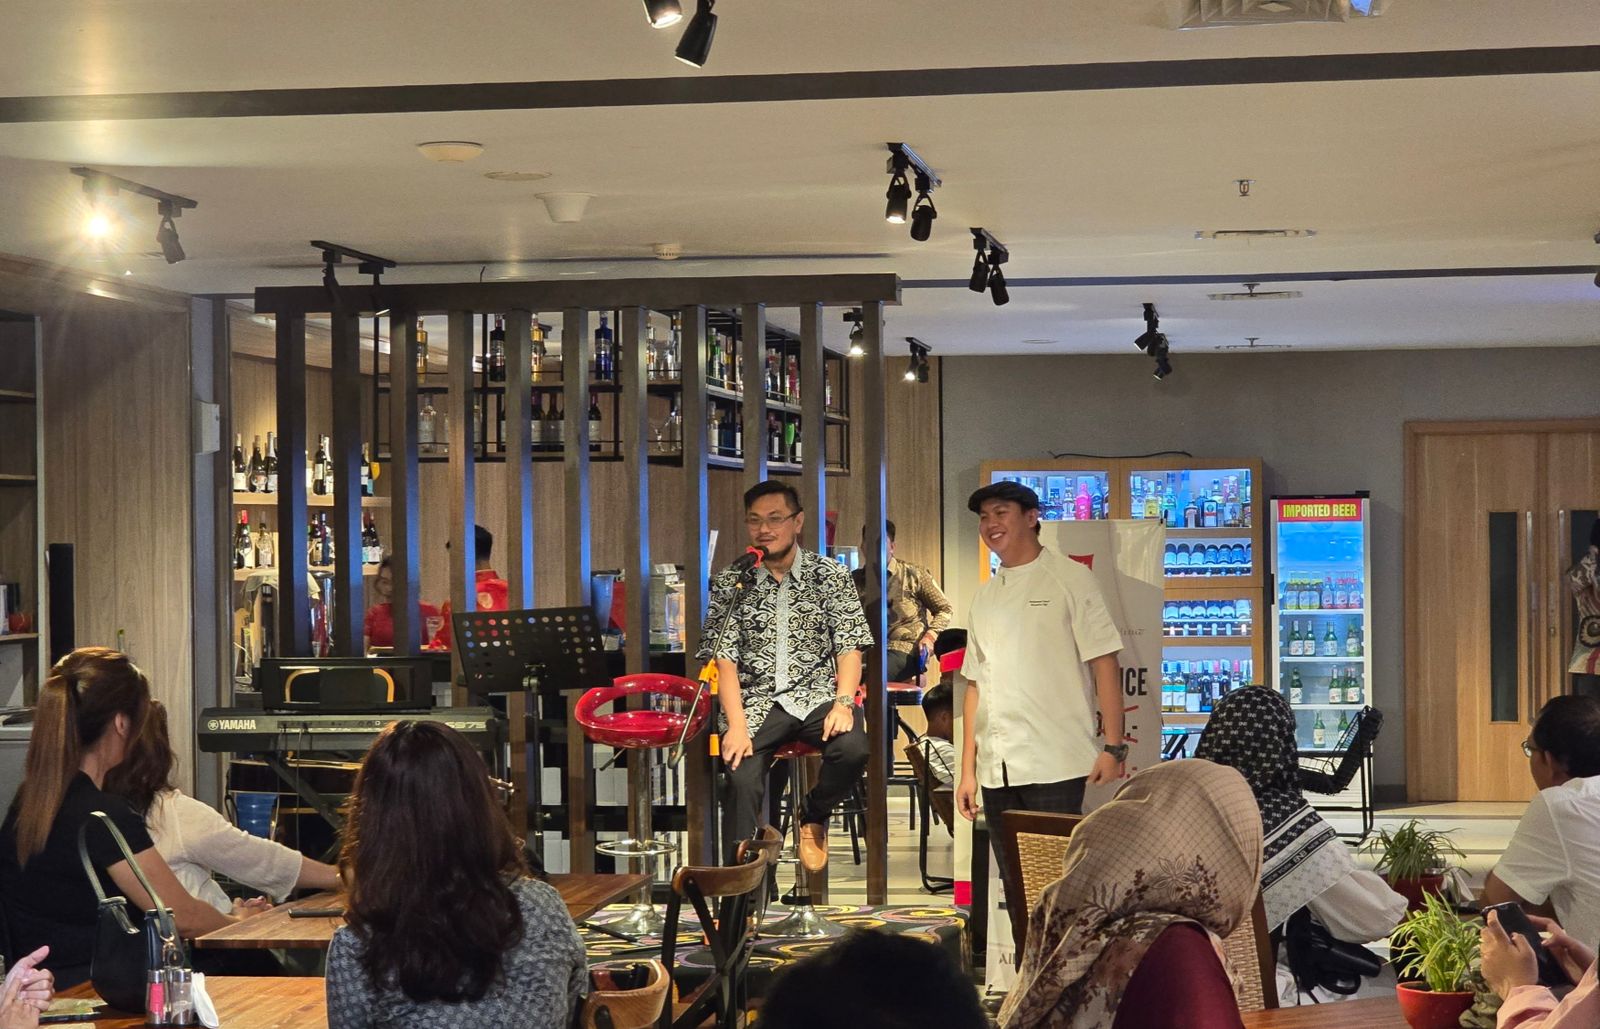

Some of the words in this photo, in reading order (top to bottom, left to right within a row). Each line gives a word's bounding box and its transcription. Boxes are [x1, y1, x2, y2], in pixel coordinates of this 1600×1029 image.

[1283, 504, 1330, 517] IMPORTED
[1333, 503, 1357, 516] BEER
[219, 719, 256, 730] YAMAHA
